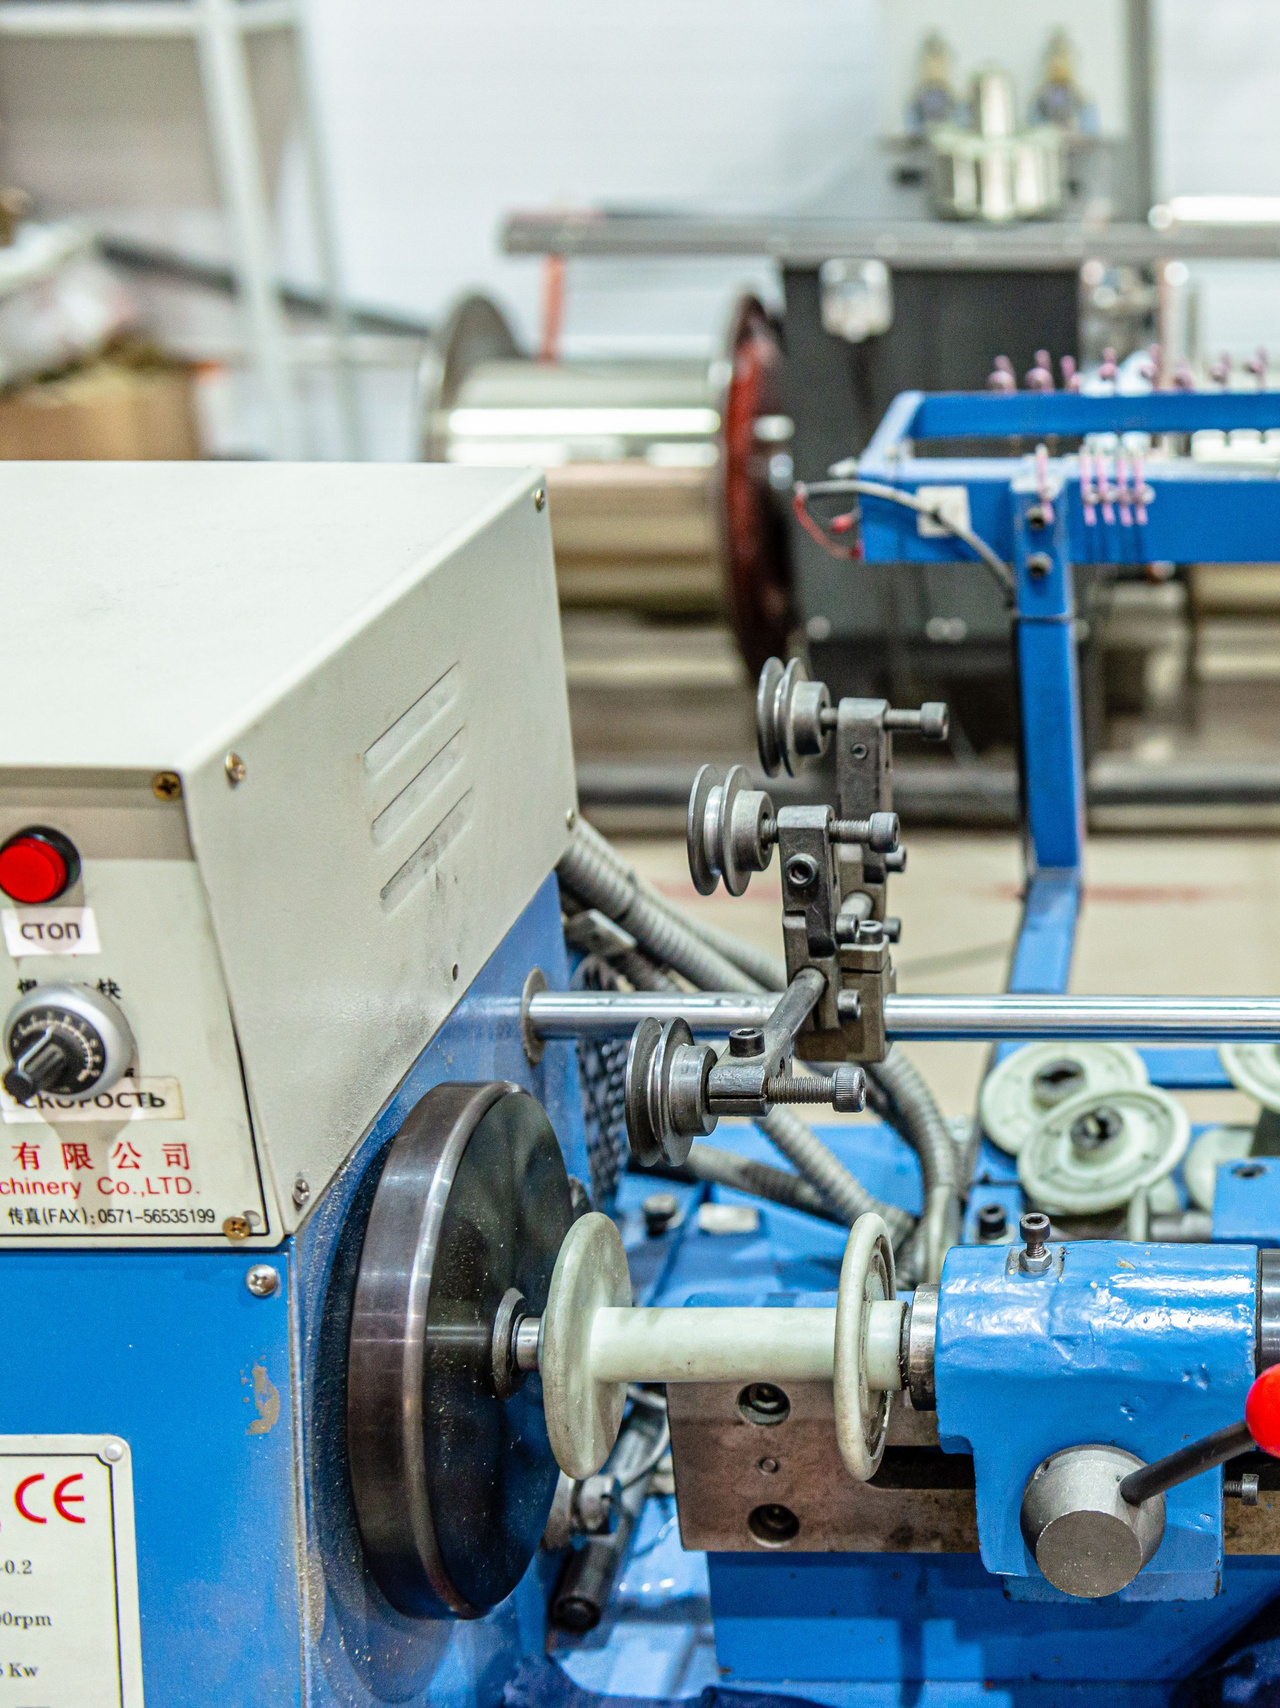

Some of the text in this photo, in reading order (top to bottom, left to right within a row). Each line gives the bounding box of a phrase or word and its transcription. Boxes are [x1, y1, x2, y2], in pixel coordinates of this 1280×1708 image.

[21, 922, 81, 940] СТОП
[11, 1141, 191, 1171] 有限公司
[96, 1176, 200, 1198] Co.,LTD.
[14, 1472, 86, 1524] CE
[0, 1611, 52, 1630] 0rpm
